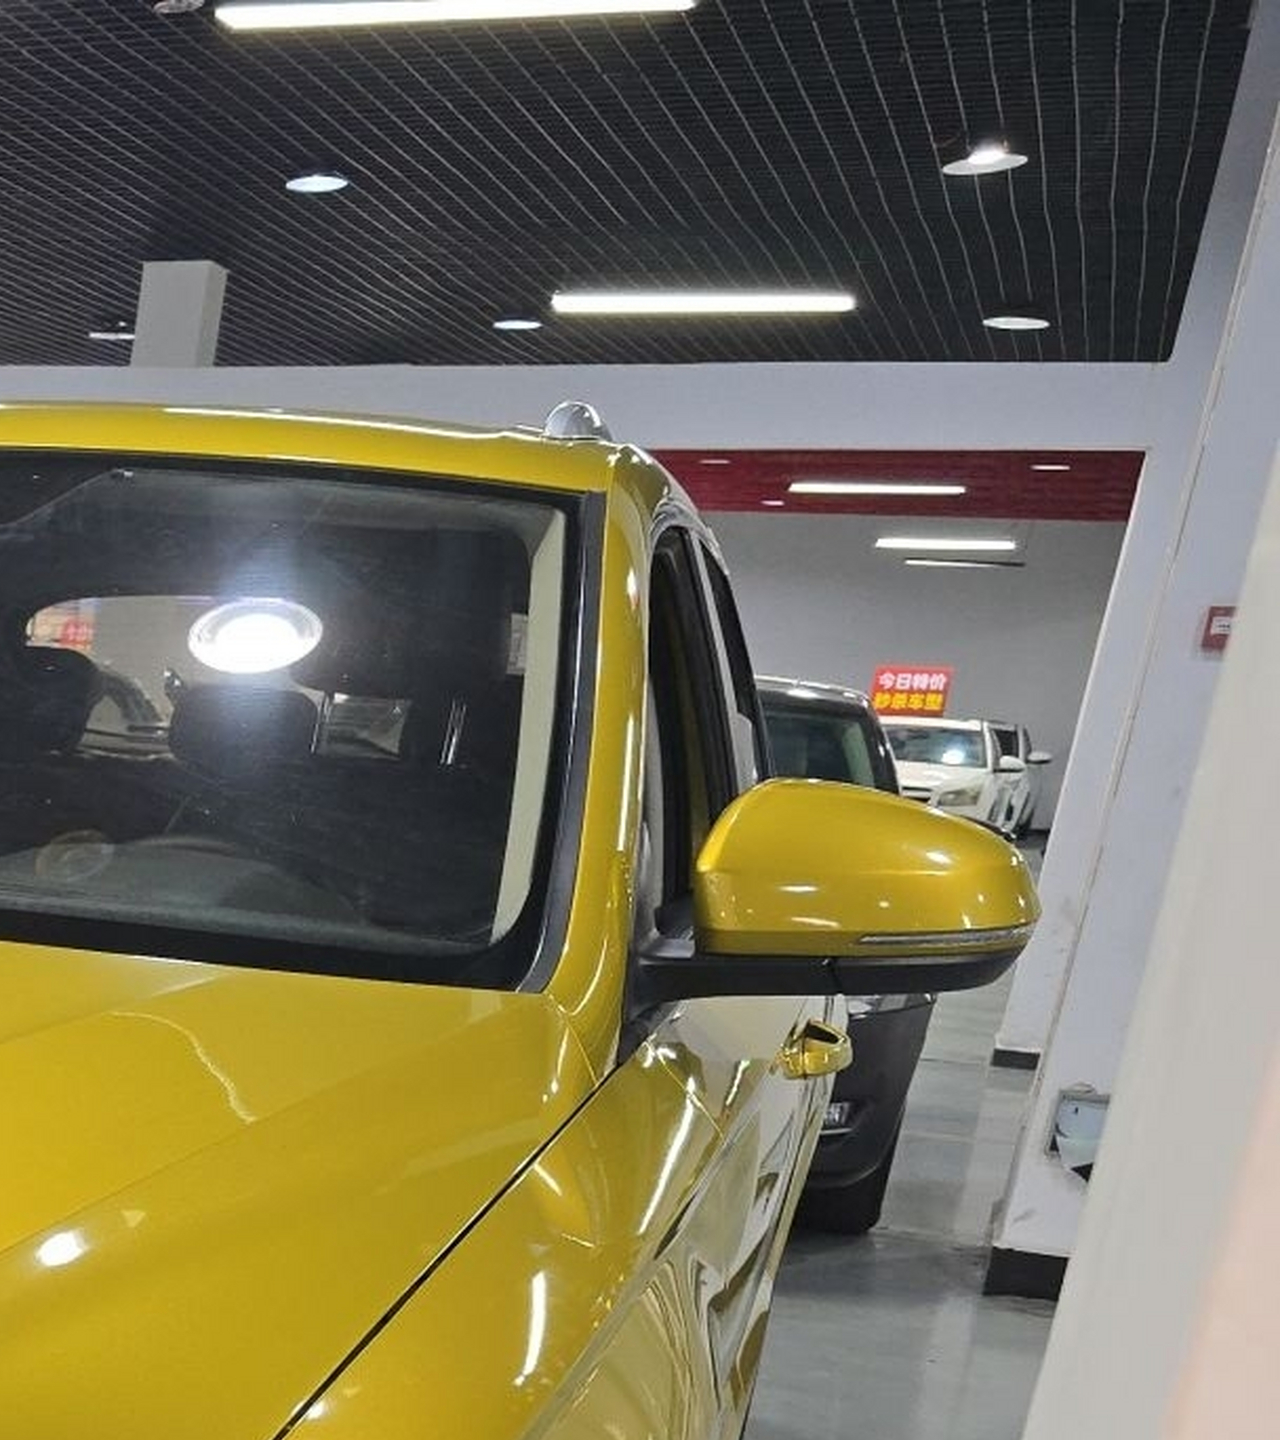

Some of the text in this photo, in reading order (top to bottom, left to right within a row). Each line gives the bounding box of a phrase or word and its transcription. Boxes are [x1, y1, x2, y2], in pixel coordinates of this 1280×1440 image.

[878, 671, 947, 691] 今日特价
[873, 692, 944, 711] 秒杀车型
